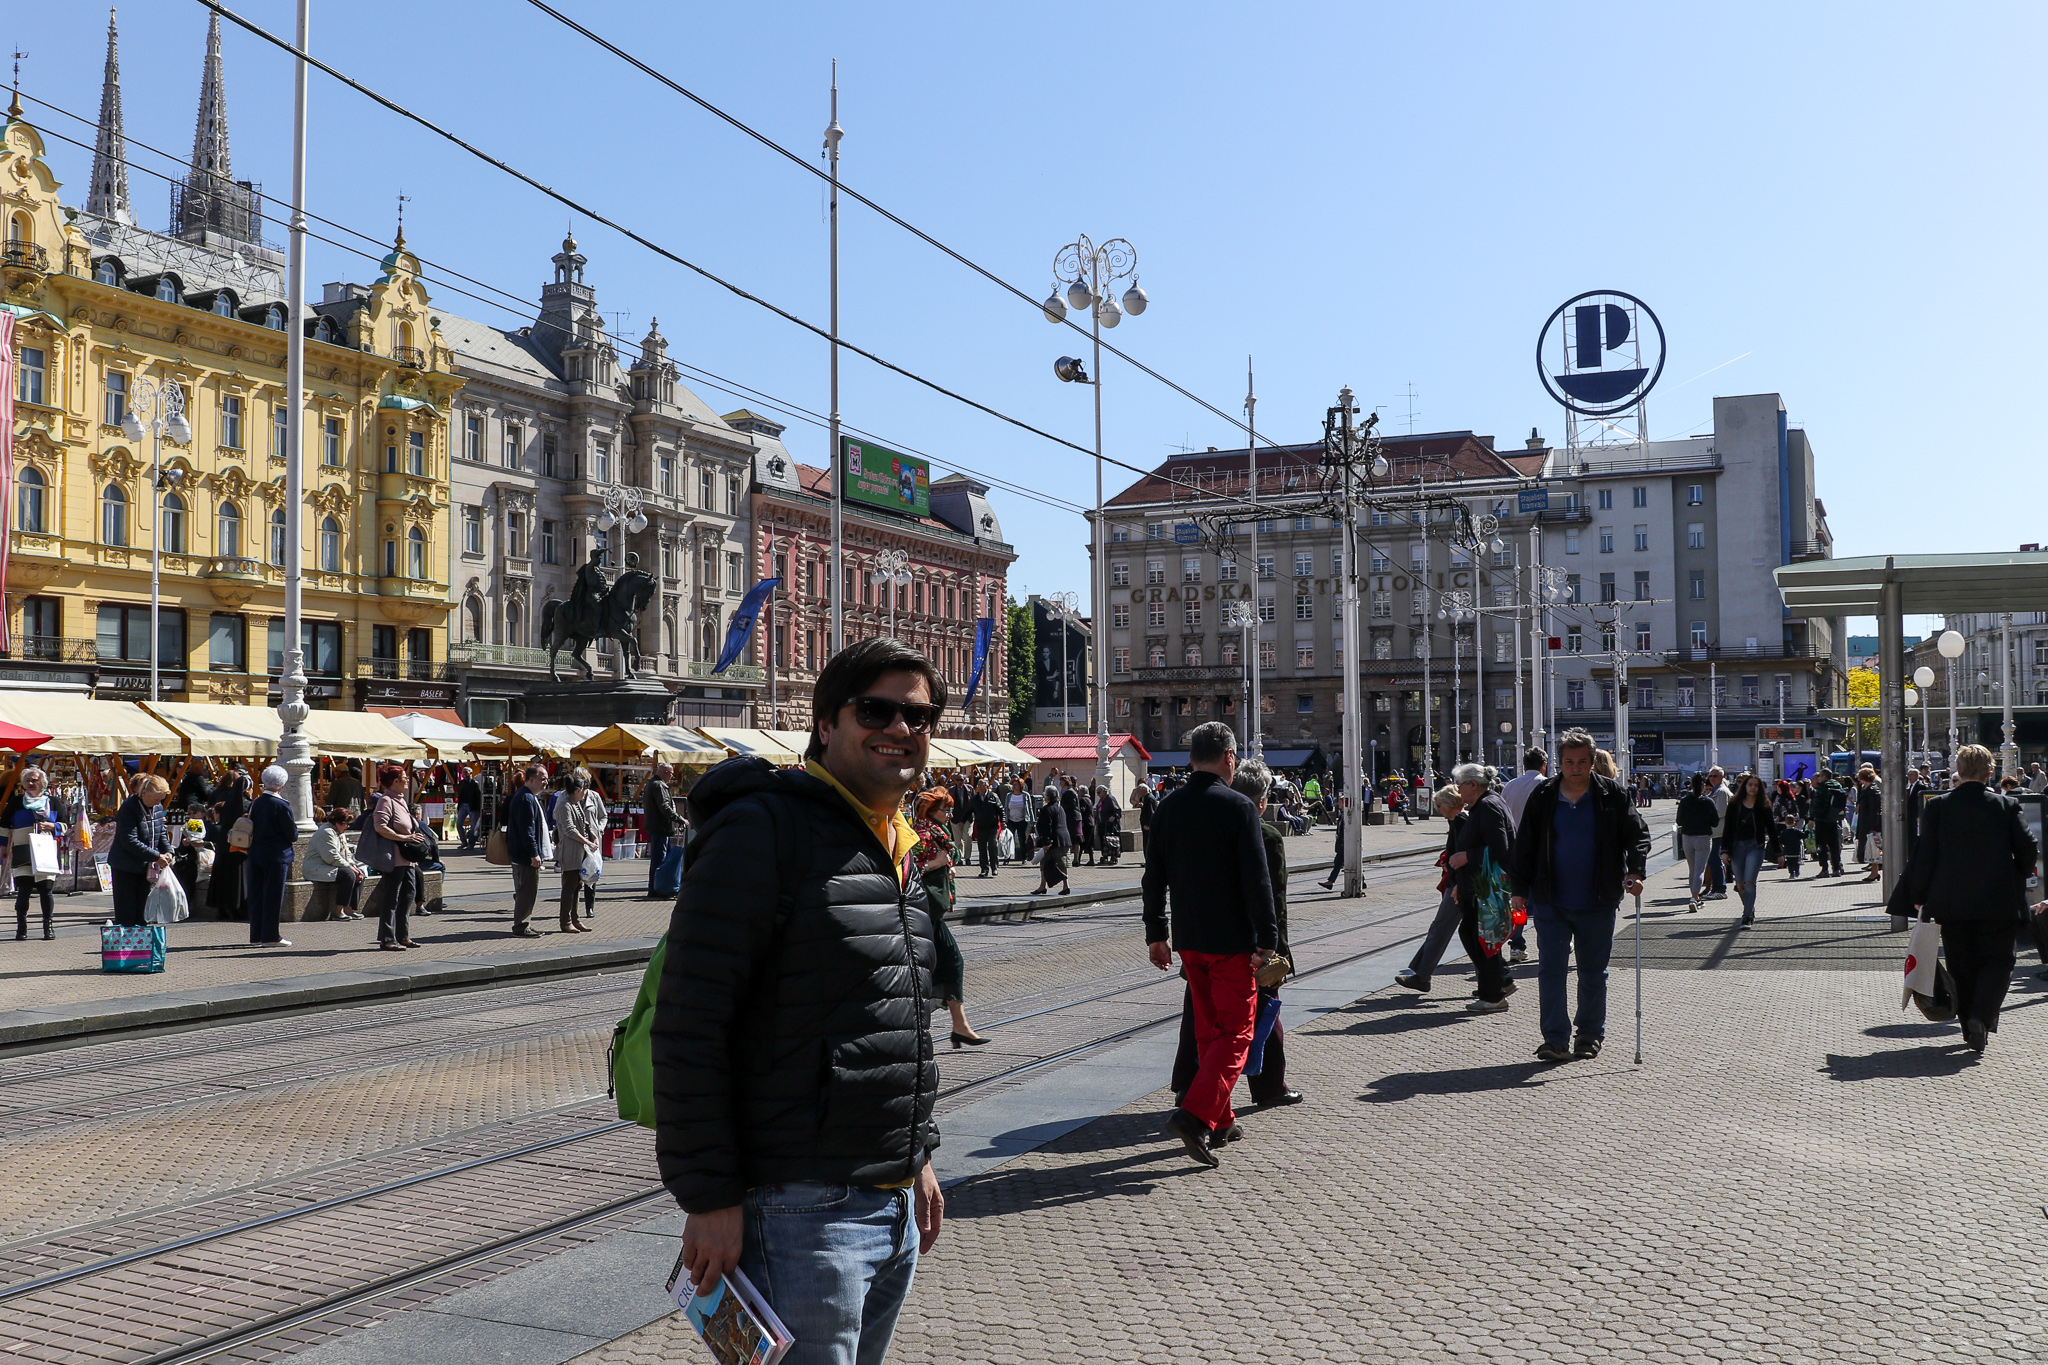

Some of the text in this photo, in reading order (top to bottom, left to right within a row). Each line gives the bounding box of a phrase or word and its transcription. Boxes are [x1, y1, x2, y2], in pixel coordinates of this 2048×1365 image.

[1130, 583, 1253, 604] GRADSKA
[0, 670, 71, 682] Galerija Mala
[420, 689, 444, 698] BASLER
[677, 1277, 696, 1309] CRO
